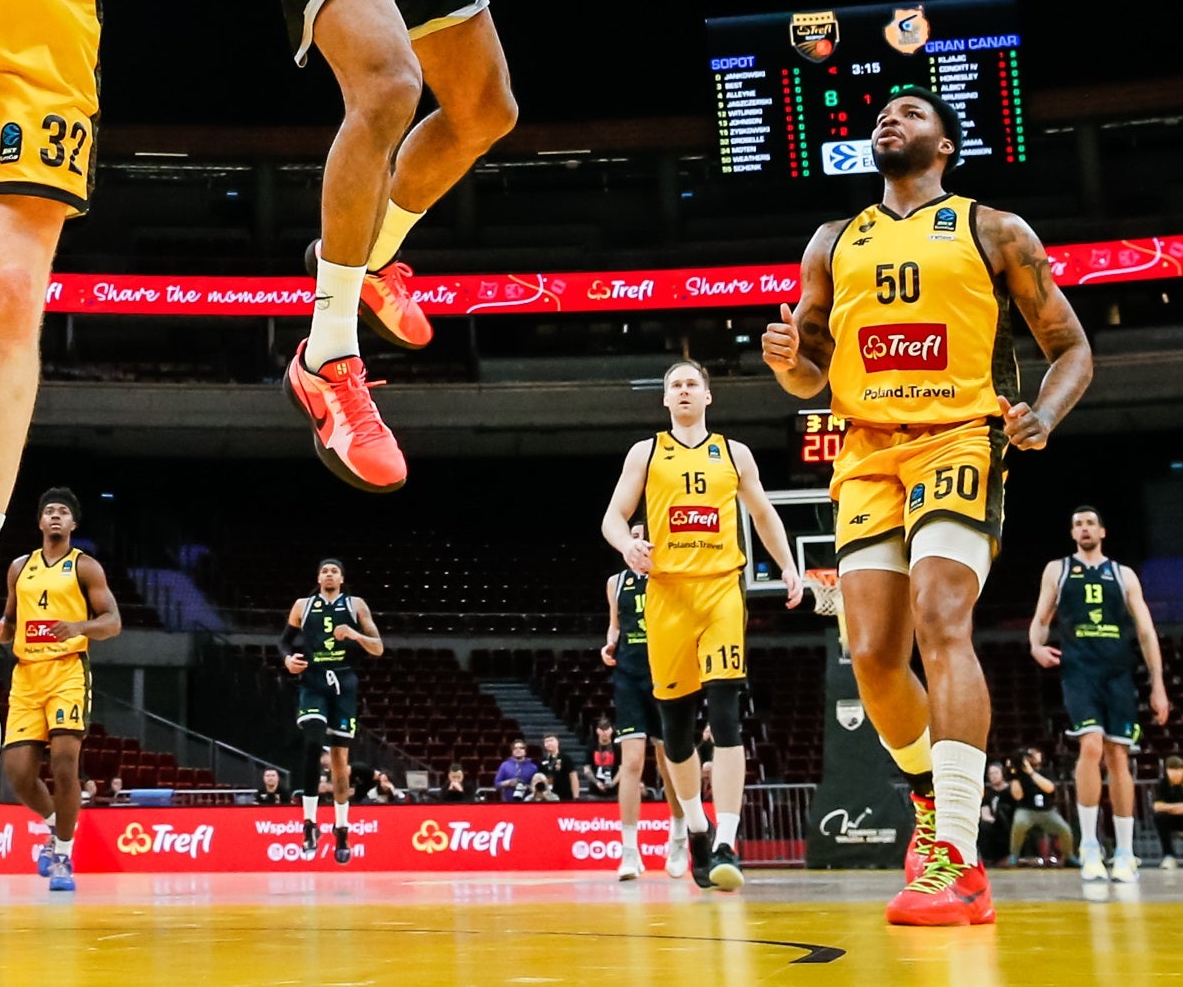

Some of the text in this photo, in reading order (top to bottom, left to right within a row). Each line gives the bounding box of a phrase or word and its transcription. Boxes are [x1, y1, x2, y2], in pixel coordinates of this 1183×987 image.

[925, 35, 1019, 53] GRAN CANAR
[710, 56, 755, 71] SOPOT
[852, 63, 881, 75] 3:15
[824, 89, 839, 107] 8
[39, 114, 87, 177] 32
[93, 282, 160, 303] Share
[165, 284, 203, 303] the
[610, 279, 655, 301] Trefl
[684, 270, 798, 297] Share the
[875, 261, 921, 306] 50
[887, 334, 942, 361] Trefl
[863, 384, 956, 401] Poland.Travel
[806, 414, 822, 433] 3
[803, 434, 840, 461] 20
[681, 472, 707, 495] 15
[934, 465, 979, 501] 50
[687, 510, 718, 528] Trefl
[849, 513, 871, 524] 4F
[38, 589, 49, 610] 4
[1084, 584, 1103, 604] 13
[323, 617, 333, 634] 5
[718, 645, 741, 670] 15
[69, 704, 80, 724] 4
[151, 821, 214, 859] Trefl
[448, 820, 514, 857] Trefl
[641, 841, 670, 860] tref
